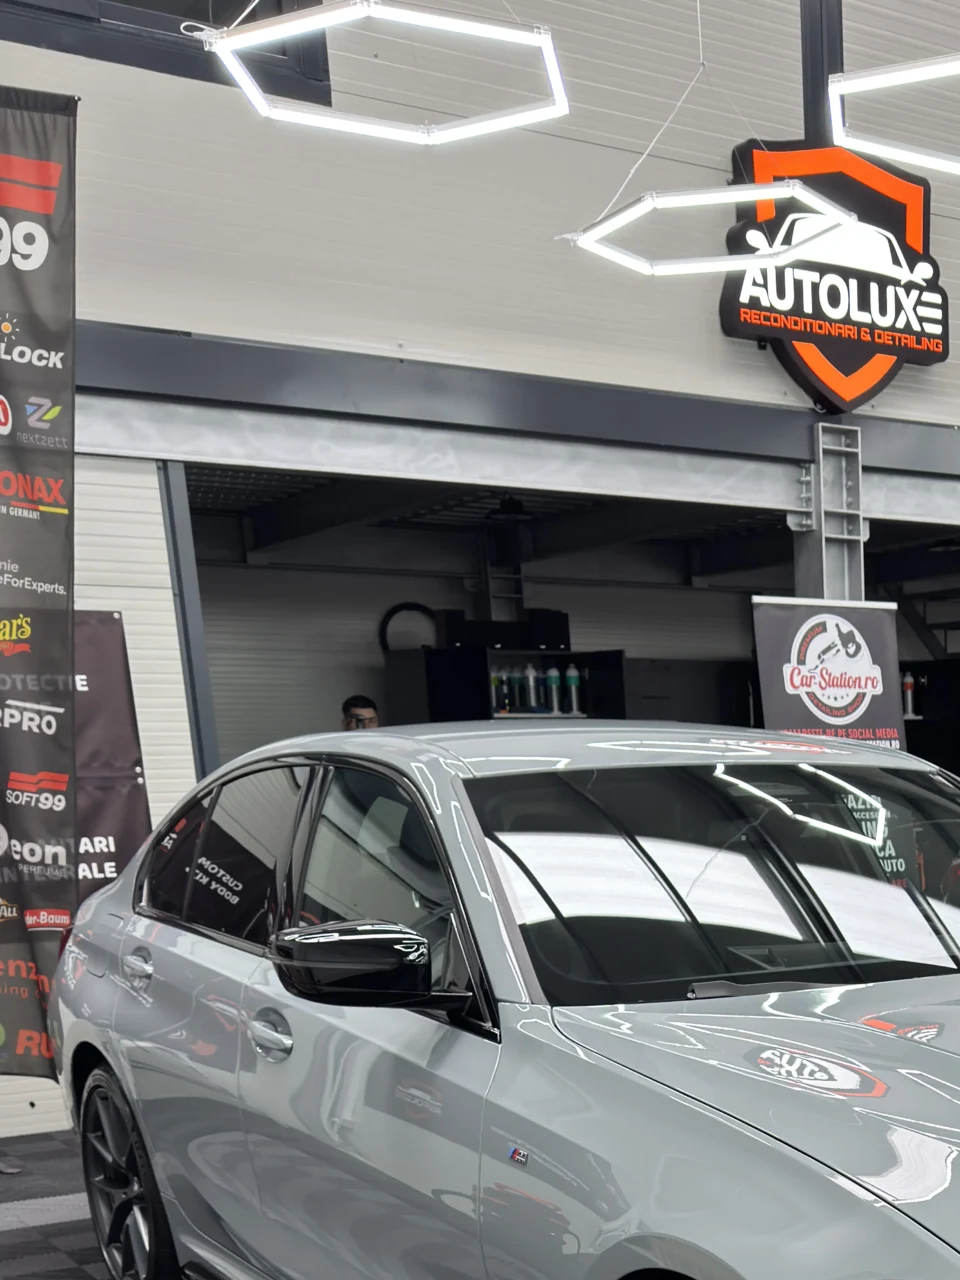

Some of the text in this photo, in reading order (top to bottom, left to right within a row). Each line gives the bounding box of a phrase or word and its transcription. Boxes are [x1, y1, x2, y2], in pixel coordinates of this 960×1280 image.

[739, 262, 943, 335] AUTOLUXE
[740, 308, 943, 353] RECONDITIONARI & DETAILING
[9, 506, 41, 520] GERMANY
[0, 707, 57, 736] PRO
[849, 728, 875, 739] SOCIAL
[876, 728, 899, 739] MEDIA
